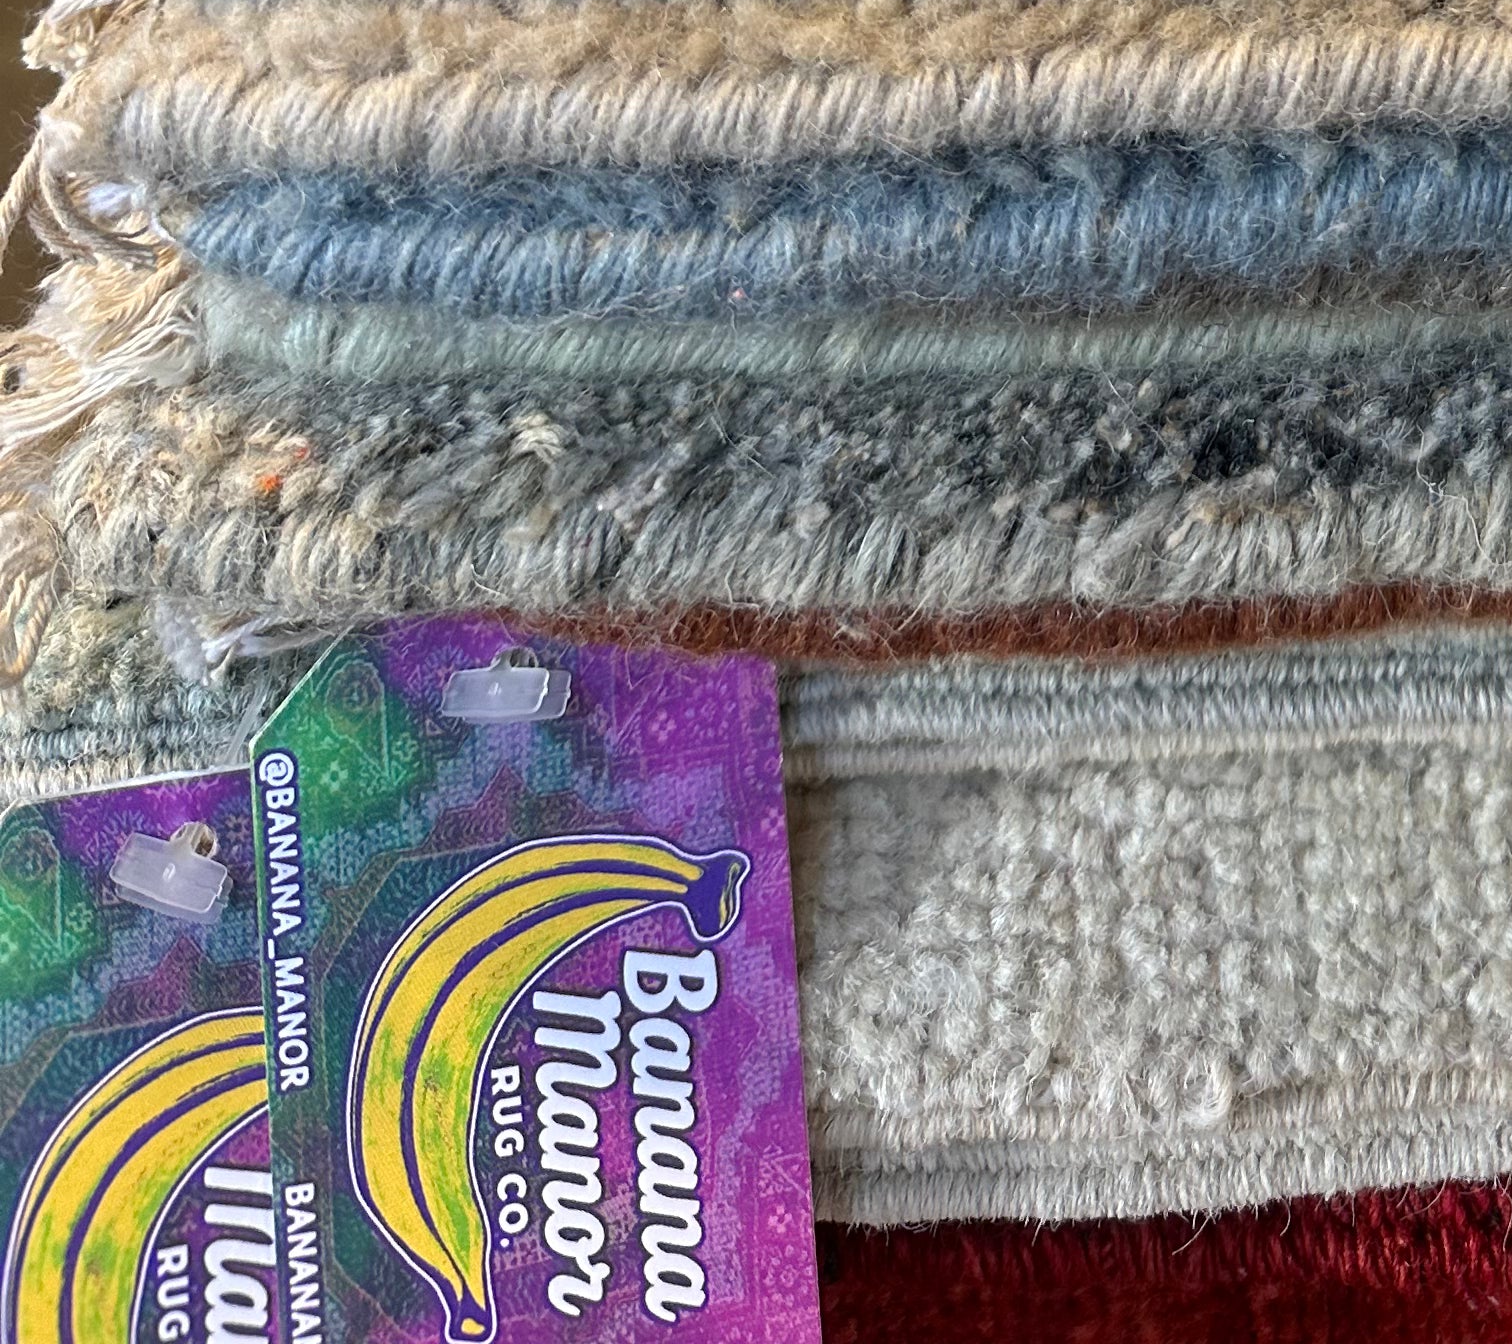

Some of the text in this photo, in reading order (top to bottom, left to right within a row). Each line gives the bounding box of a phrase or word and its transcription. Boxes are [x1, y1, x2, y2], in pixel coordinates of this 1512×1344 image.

[258, 752, 310, 1092] @BANANA_MANOR
[285, 1182, 322, 1344] BANANA
[490, 1064, 530, 1249] RUG CO.
[532, 990, 622, 1317] Manor
[623, 949, 718, 1323] Banana
[157, 1243, 191, 1343] RUG
